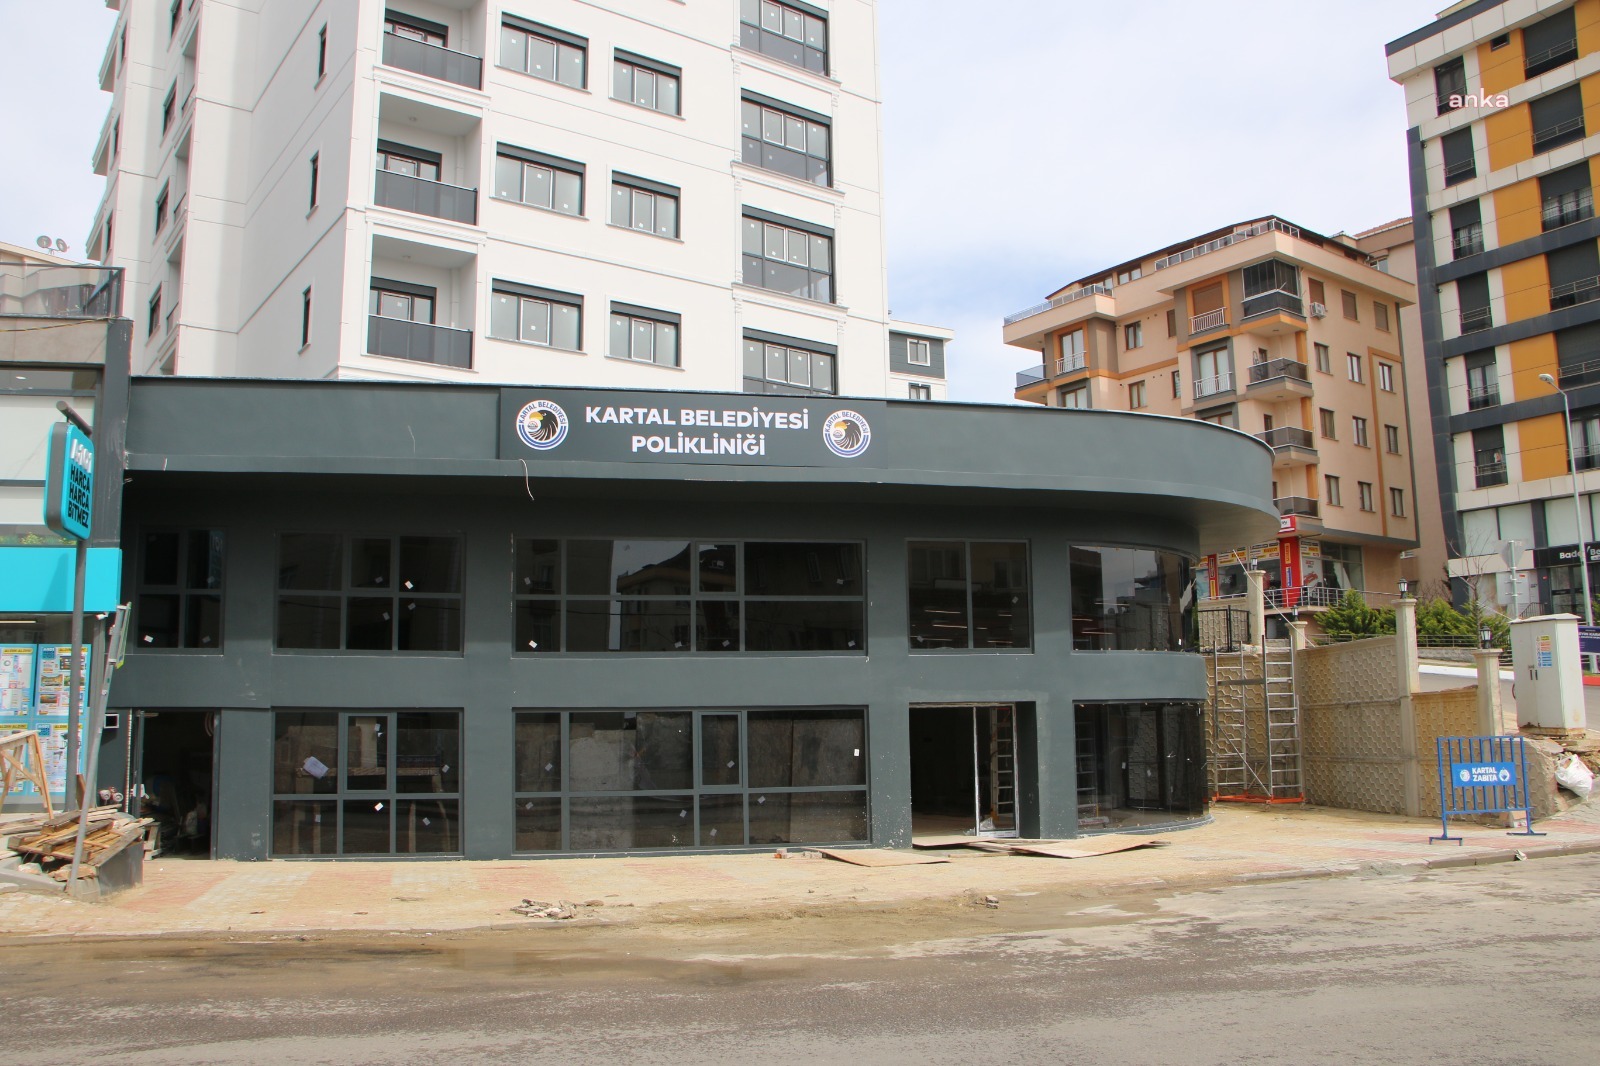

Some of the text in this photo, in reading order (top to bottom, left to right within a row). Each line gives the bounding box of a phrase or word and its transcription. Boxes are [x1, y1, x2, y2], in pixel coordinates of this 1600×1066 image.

[518, 403, 537, 424] KARTAL
[585, 406, 809, 430] KARTAL BELEDİYESİ
[824, 413, 841, 433] KARTAL
[631, 431, 766, 456] POLİKLİNİĞİ
[71, 464, 90, 492] HARCA
[69, 482, 89, 510] HARCA
[1472, 774, 1498, 782] ZABITA
